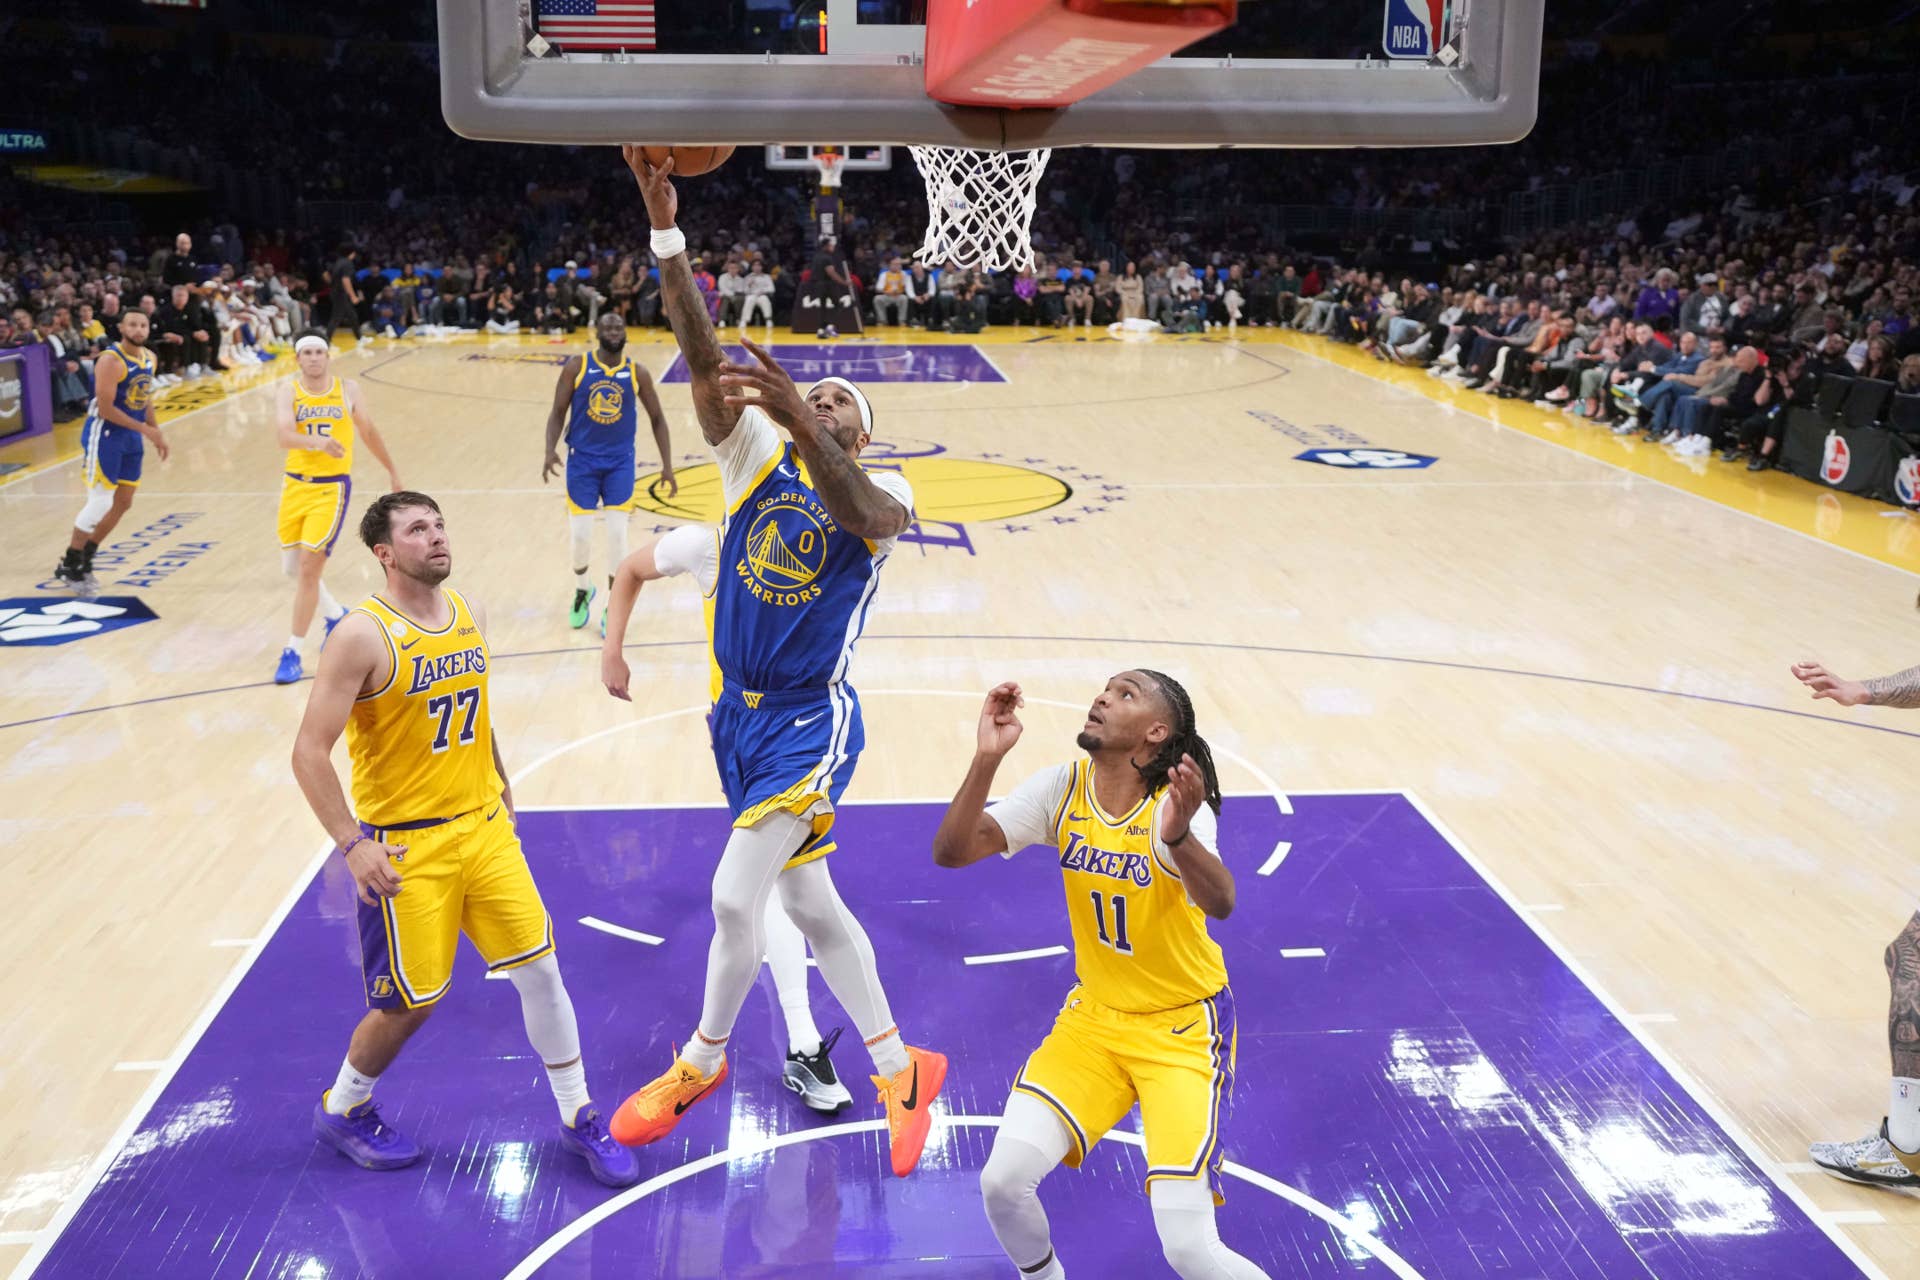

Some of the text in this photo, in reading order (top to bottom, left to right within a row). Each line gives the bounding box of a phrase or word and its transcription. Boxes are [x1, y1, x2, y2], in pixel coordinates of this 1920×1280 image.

[1392, 25, 1421, 49] NBA
[296, 403, 343, 422] LAKERS
[798, 530, 815, 554] 0
[809, 502, 838, 534] STATE
[112, 541, 221, 588] ARENA
[736, 558, 822, 607] WARRIORS
[405, 646, 487, 697] LAKERS
[427, 685, 480, 754] 77
[1060, 832, 1152, 888] LAKERS
[1090, 890, 1134, 956] 11
